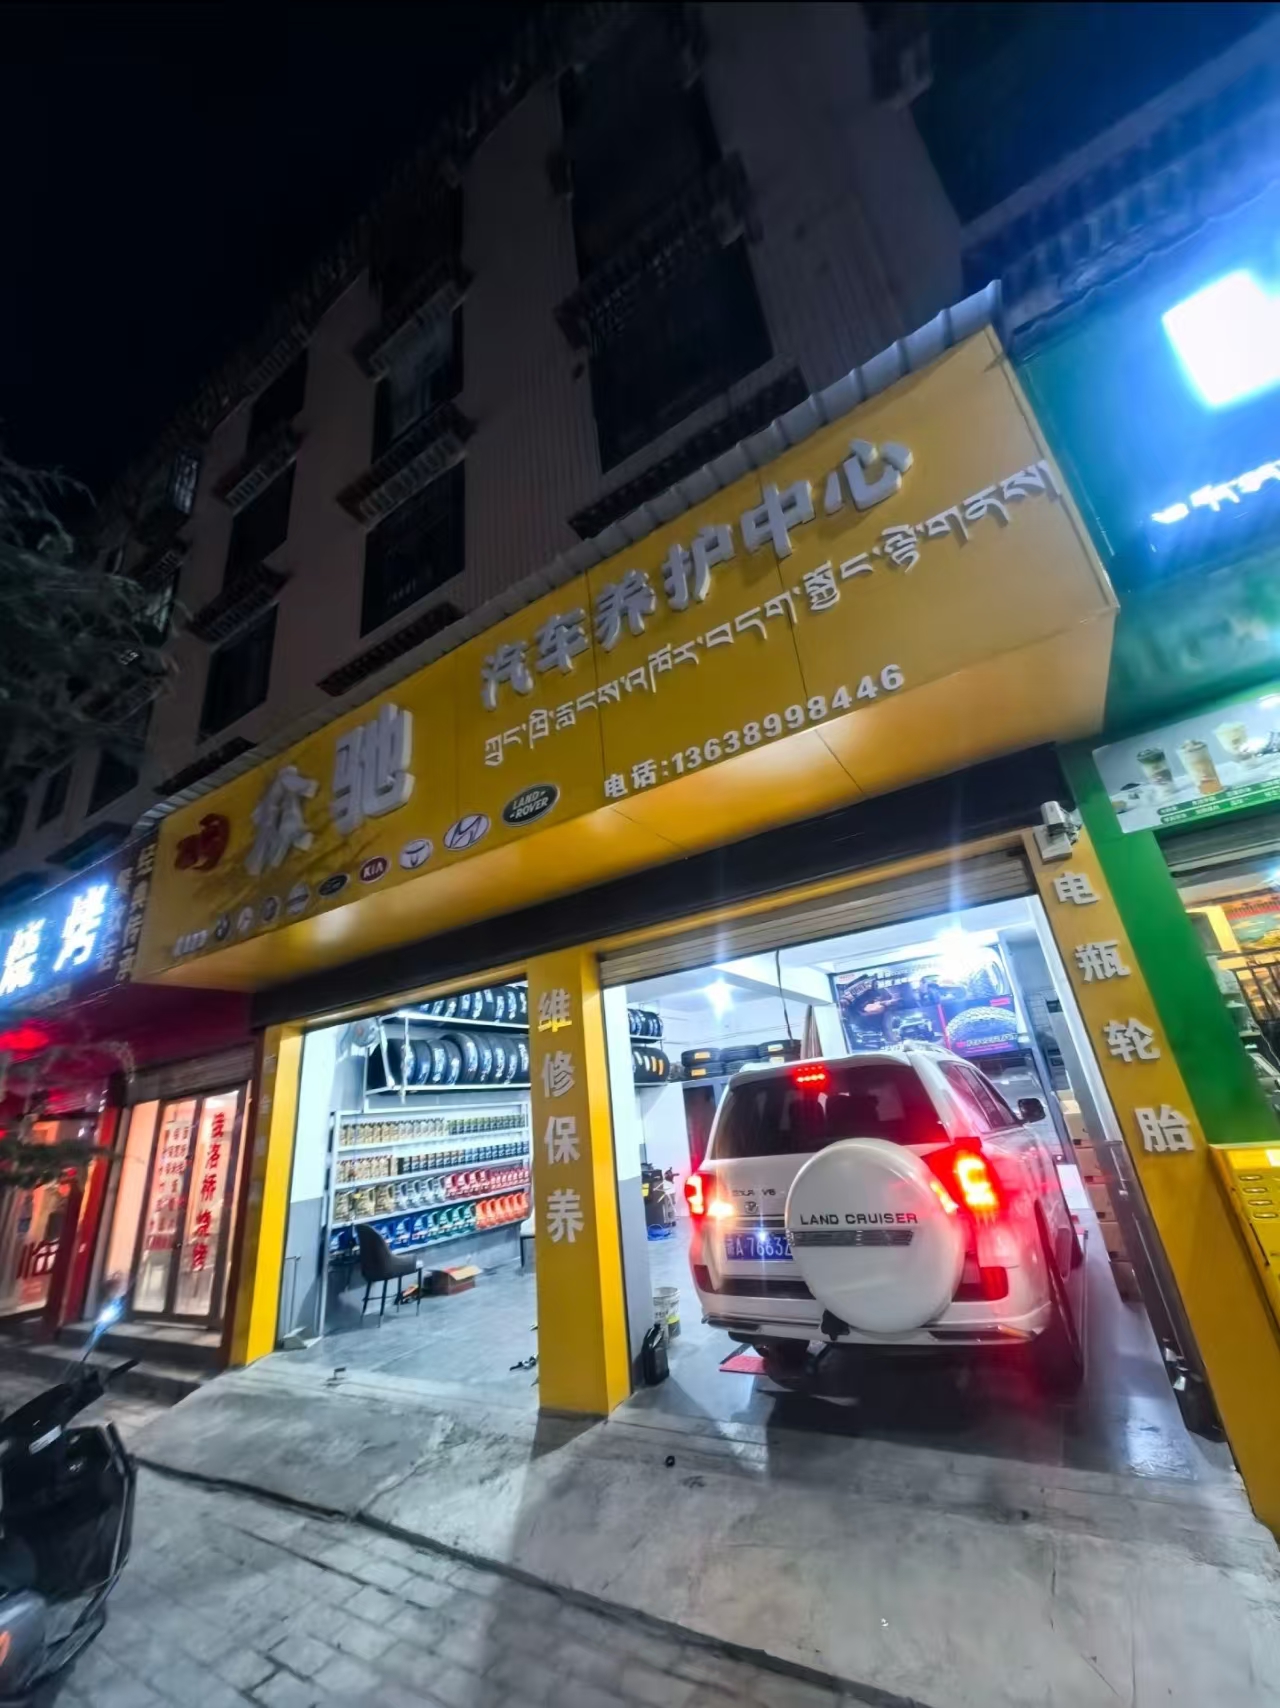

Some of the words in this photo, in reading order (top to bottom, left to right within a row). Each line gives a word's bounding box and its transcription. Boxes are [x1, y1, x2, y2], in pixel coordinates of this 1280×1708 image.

[480, 439, 914, 712] 汽车养护中心
[363, 861, 385, 879] KIA
[538, 988, 585, 1243] 维修保养
[1051, 869, 1196, 1155] 电瓶轮胎
[800, 1213, 839, 1226] LAND
[845, 1212, 919, 1225] CRUISER
